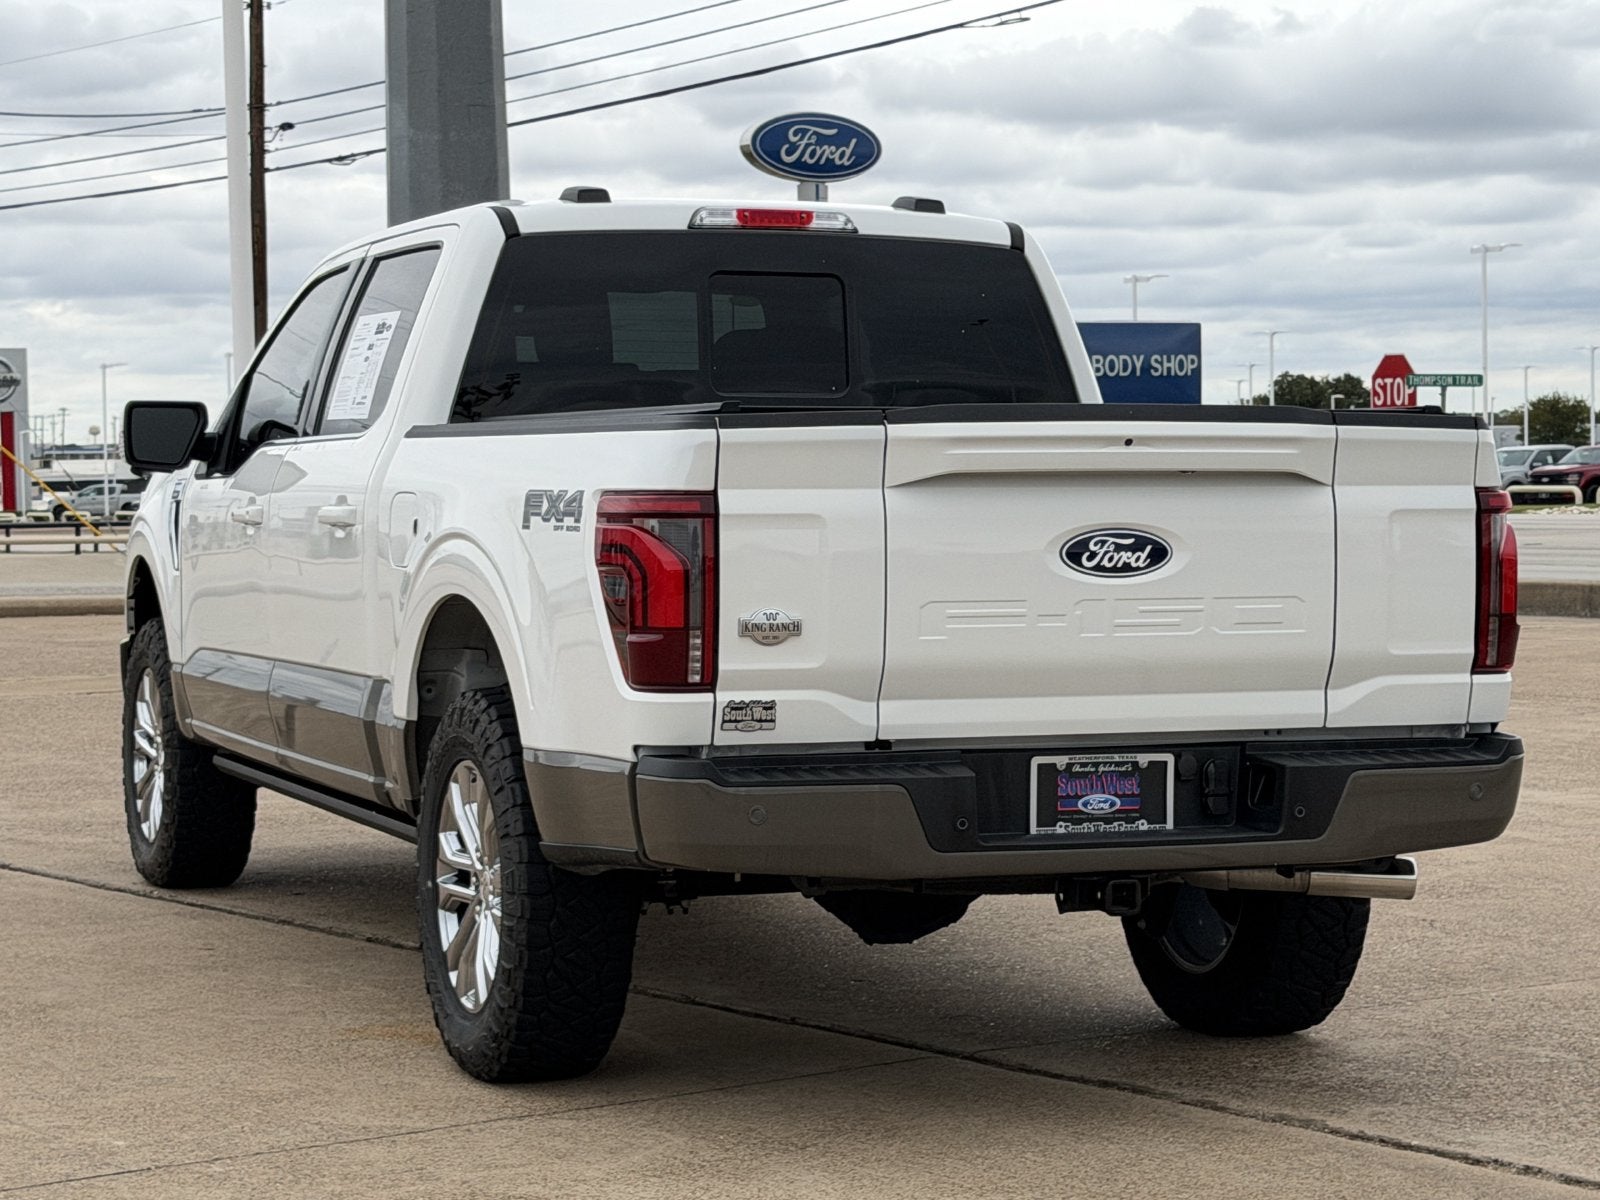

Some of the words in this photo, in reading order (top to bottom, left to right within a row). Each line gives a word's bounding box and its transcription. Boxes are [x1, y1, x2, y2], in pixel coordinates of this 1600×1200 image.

[780, 124, 858, 166] Ford
[1091, 354, 1144, 377] BODY
[1150, 354, 1199, 376] SHOP
[1374, 377, 1416, 406] STOP
[1408, 375, 1453, 386] THOMPSON
[1455, 375, 1480, 386] TRAIL
[521, 489, 585, 530] FX4
[1081, 536, 1152, 568] Ford
[744, 621, 767, 633] KING
[768, 621, 800, 633] RANCH
[919, 595, 1306, 640] F-150
[1086, 797, 1112, 810] Ford
